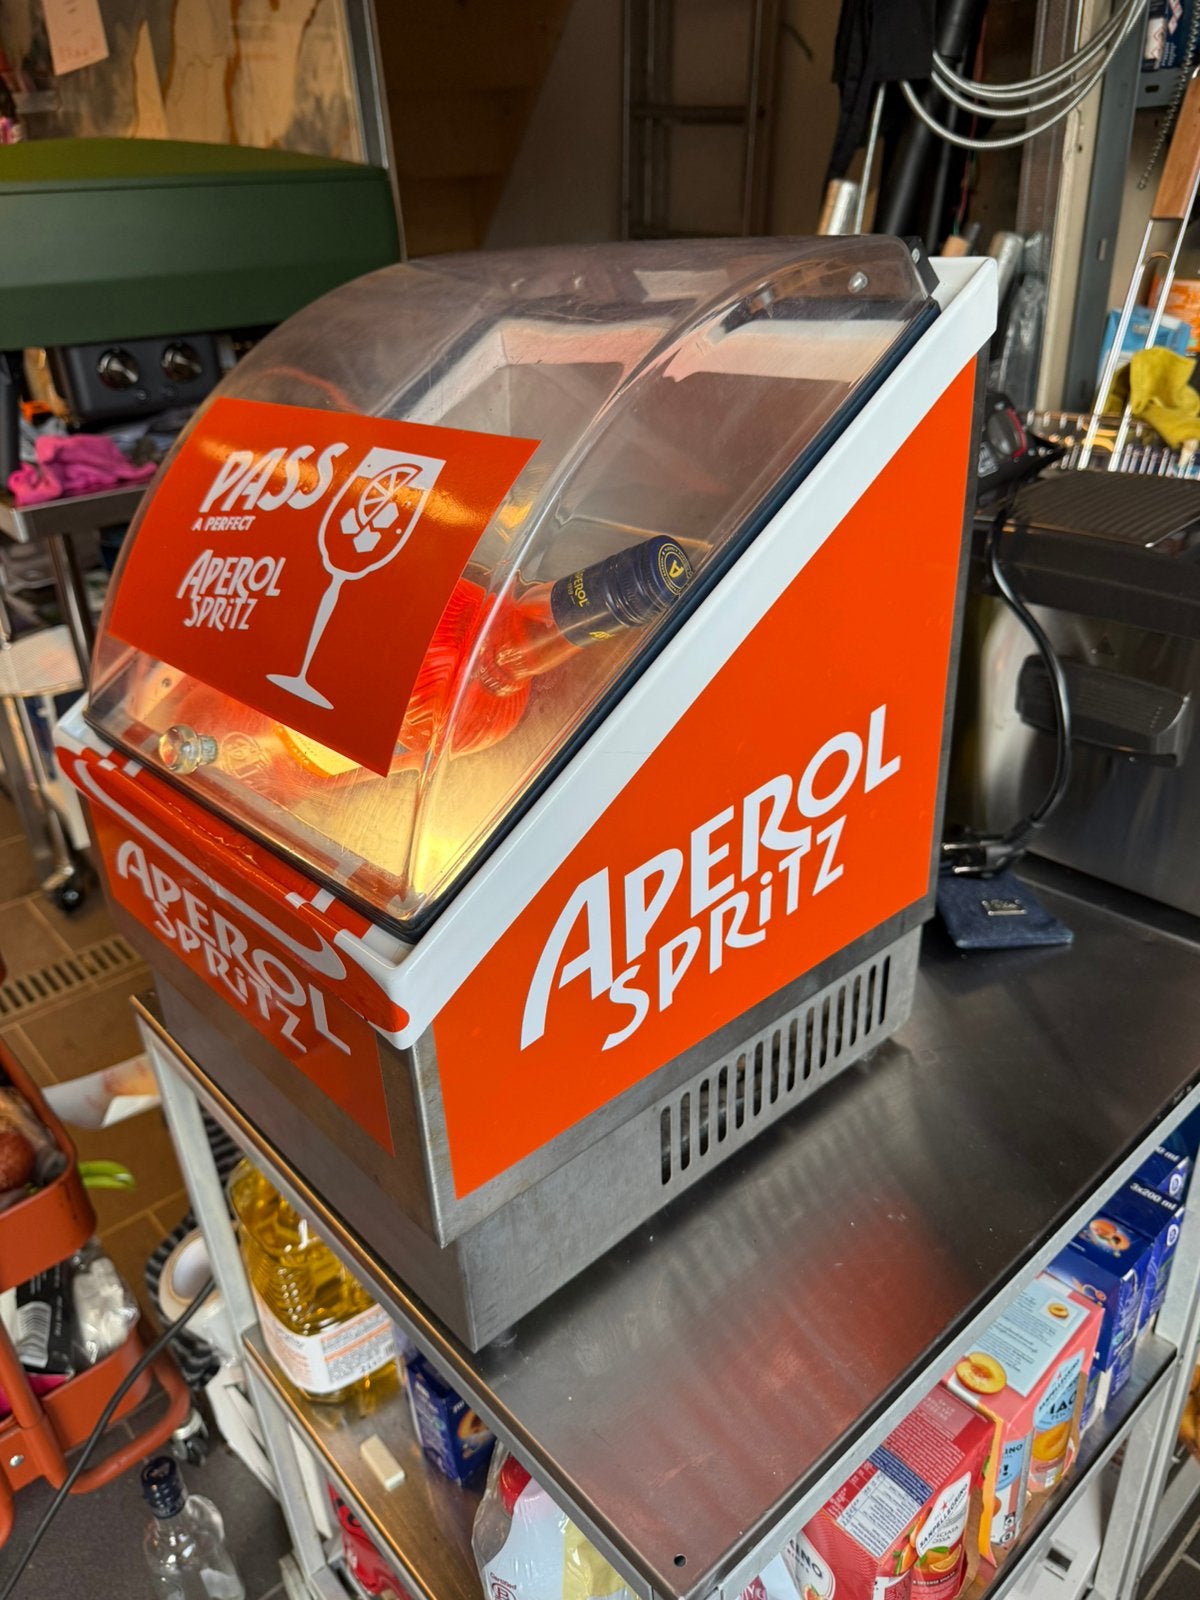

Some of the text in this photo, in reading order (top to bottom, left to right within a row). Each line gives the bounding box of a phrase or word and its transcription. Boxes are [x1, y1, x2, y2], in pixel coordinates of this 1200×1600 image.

[199, 442, 349, 513] PASS
[191, 515, 256, 531] A PERFECT
[176, 549, 286, 600] APEROL
[520, 704, 900, 1051] APEROL
[117, 840, 350, 1055] APEROL
[1130, 1182, 1178, 1211] 3x200 ml
[490, 1572, 517, 1590] Certified
